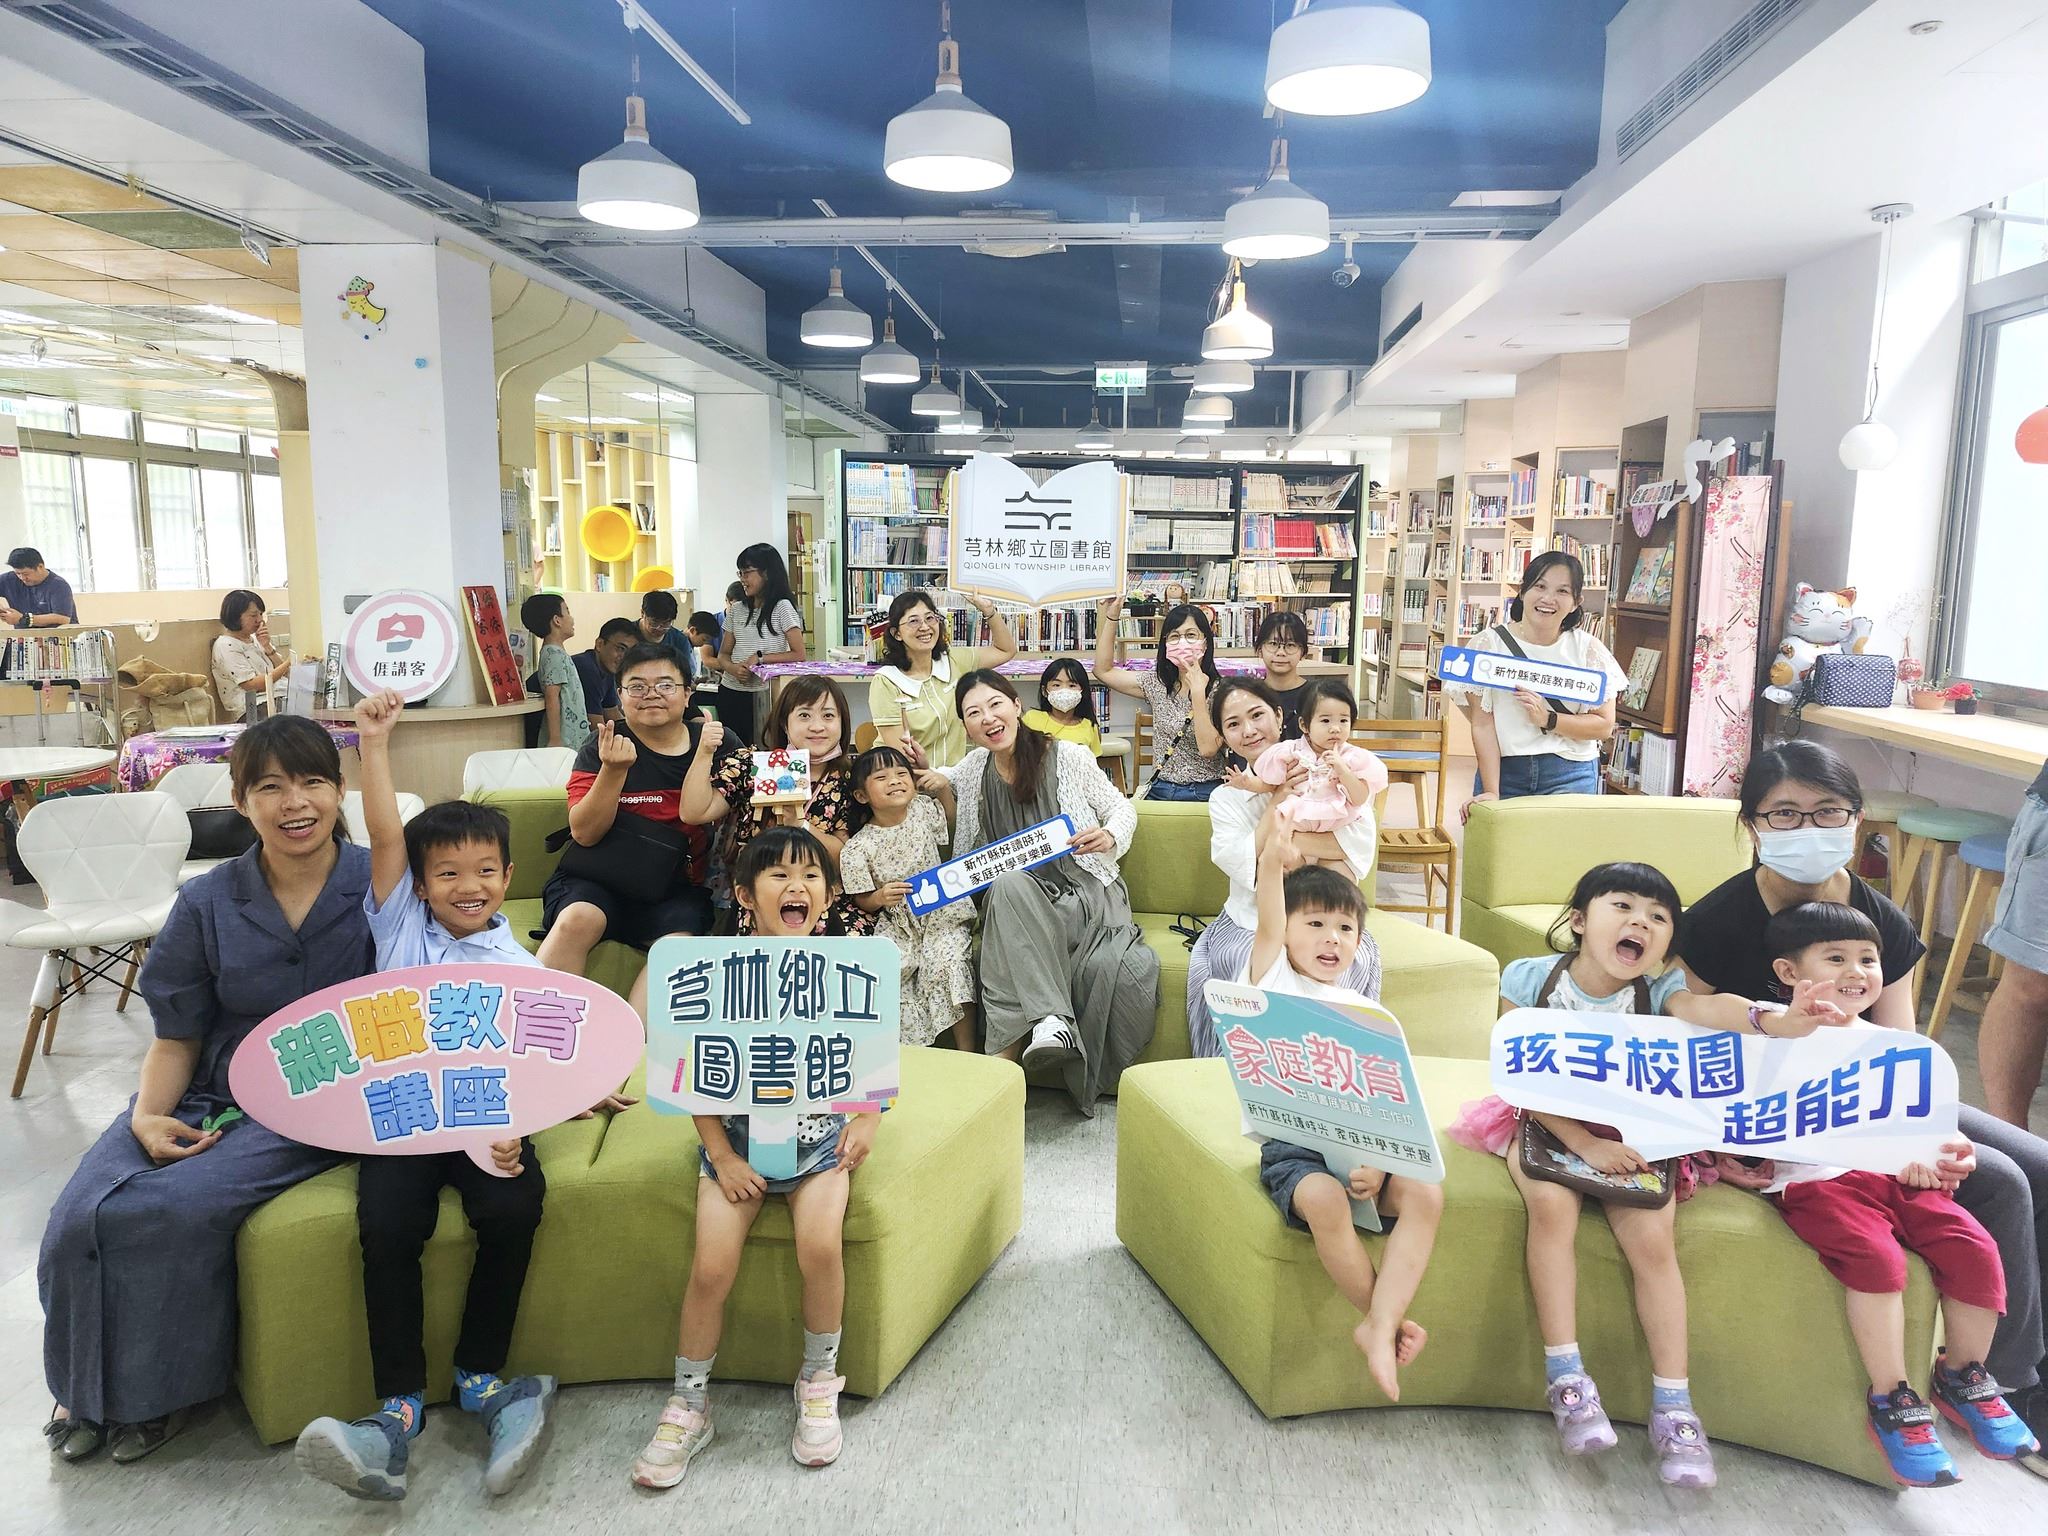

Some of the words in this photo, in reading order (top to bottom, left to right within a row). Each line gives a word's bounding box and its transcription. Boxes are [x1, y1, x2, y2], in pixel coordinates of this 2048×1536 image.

[963, 537, 1113, 560] 芎林鄉立圖書館
[963, 561, 1011, 571] QIONGLIN
[1014, 562, 1067, 572] TOWNSHIP
[1069, 563, 1112, 573] LIBRARY
[1493, 666, 1598, 693] 新竹縣家庭教育中心
[963, 828, 1048, 873] 新竹縣好讀時光
[968, 842, 1054, 886] 家庭共學享樂趣
[666, 947, 882, 1025] 芎林鄉立
[265, 981, 588, 1099] 親職教育
[691, 1032, 855, 1107] 圖書館
[1225, 1025, 1408, 1105] 家庭教育
[1502, 1030, 1746, 1101] 孩子校園
[361, 1065, 512, 1144] 講座
[1722, 1045, 1934, 1147] 超能力
[1247, 1102, 1330, 1137] 新竹縣好讀時光
[1334, 1126, 1432, 1164] 家庭共學享樂趣
